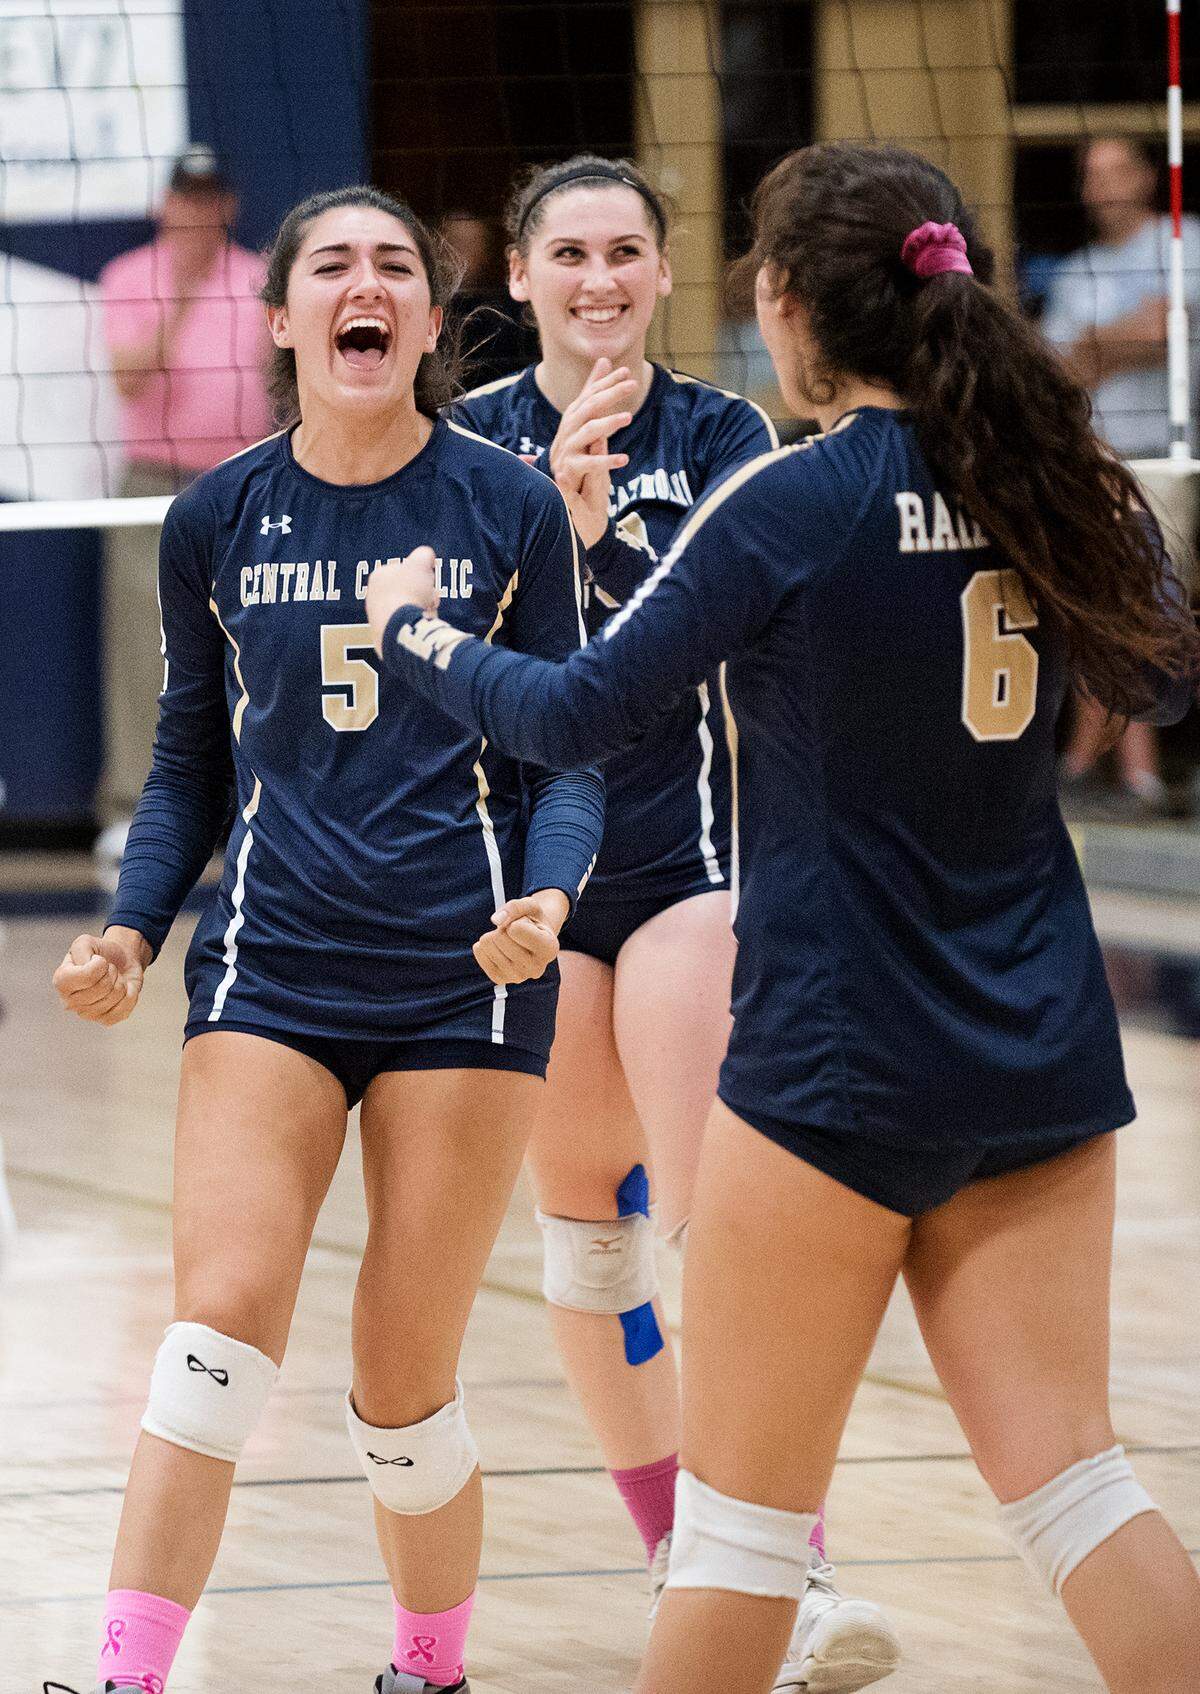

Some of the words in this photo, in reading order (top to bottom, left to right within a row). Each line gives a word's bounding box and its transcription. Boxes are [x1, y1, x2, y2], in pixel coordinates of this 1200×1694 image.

[240, 560, 341, 608] CENTRAL
[355, 557, 473, 600] CLIC
[320, 623, 379, 732] 5
[960, 569, 1039, 742] 6
